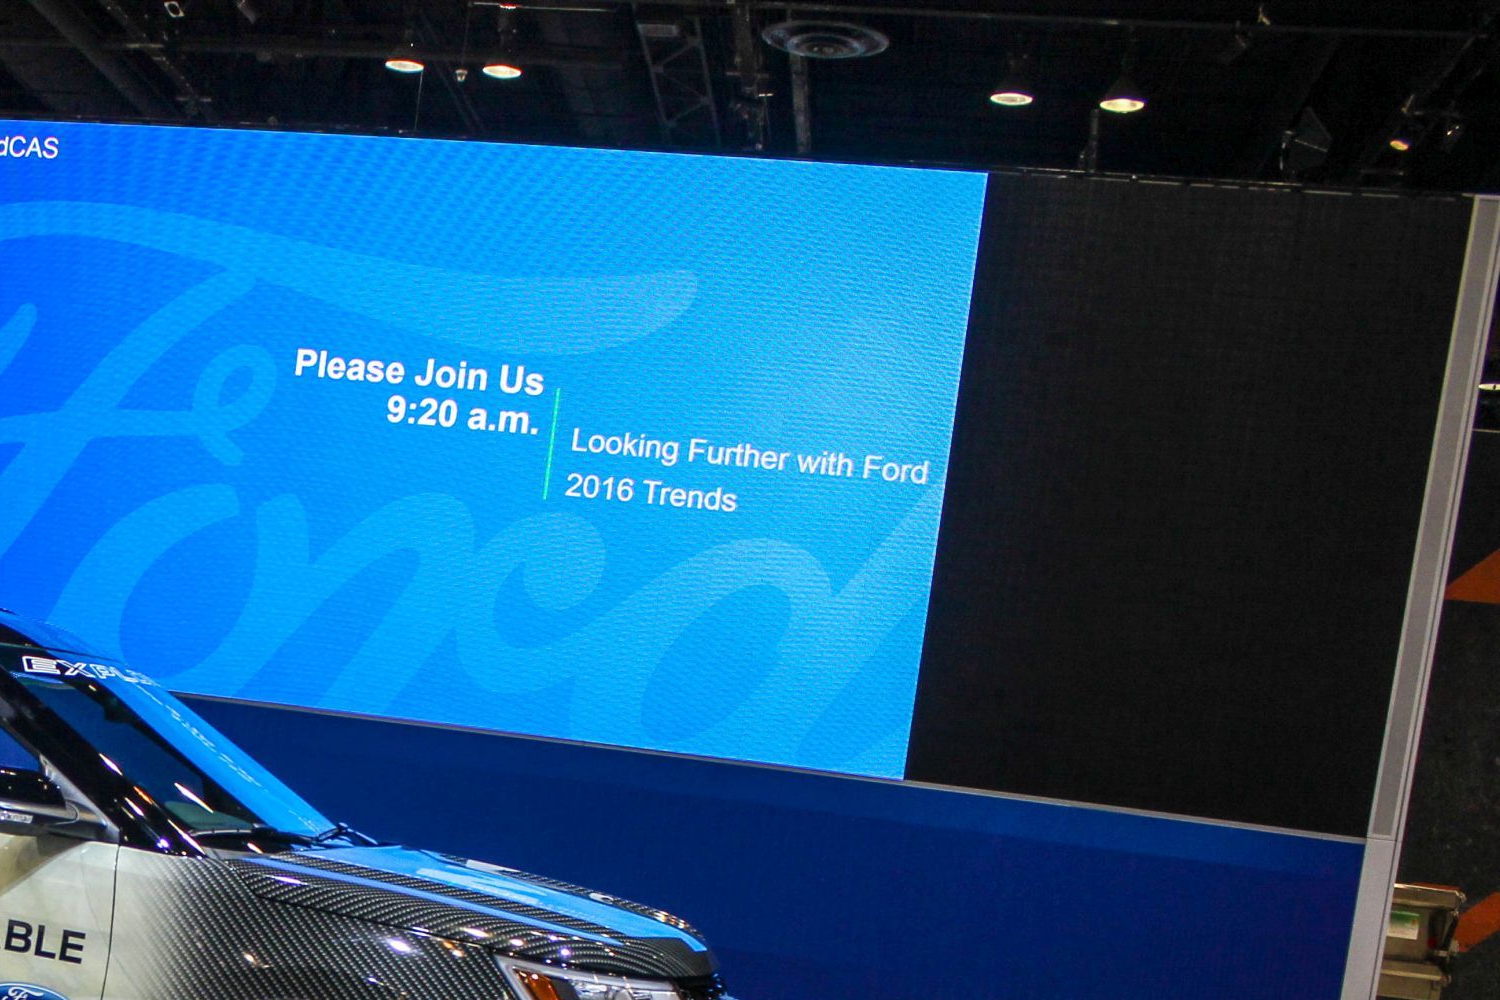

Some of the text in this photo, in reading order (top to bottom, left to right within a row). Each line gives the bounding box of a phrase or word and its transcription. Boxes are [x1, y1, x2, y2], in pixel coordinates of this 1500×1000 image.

[294, 347, 545, 396] Please Join Us
[386, 394, 539, 435] 9:20 a.m.
[571, 427, 930, 485] Looking Further with Ford
[564, 472, 738, 513] 2016 Trends
